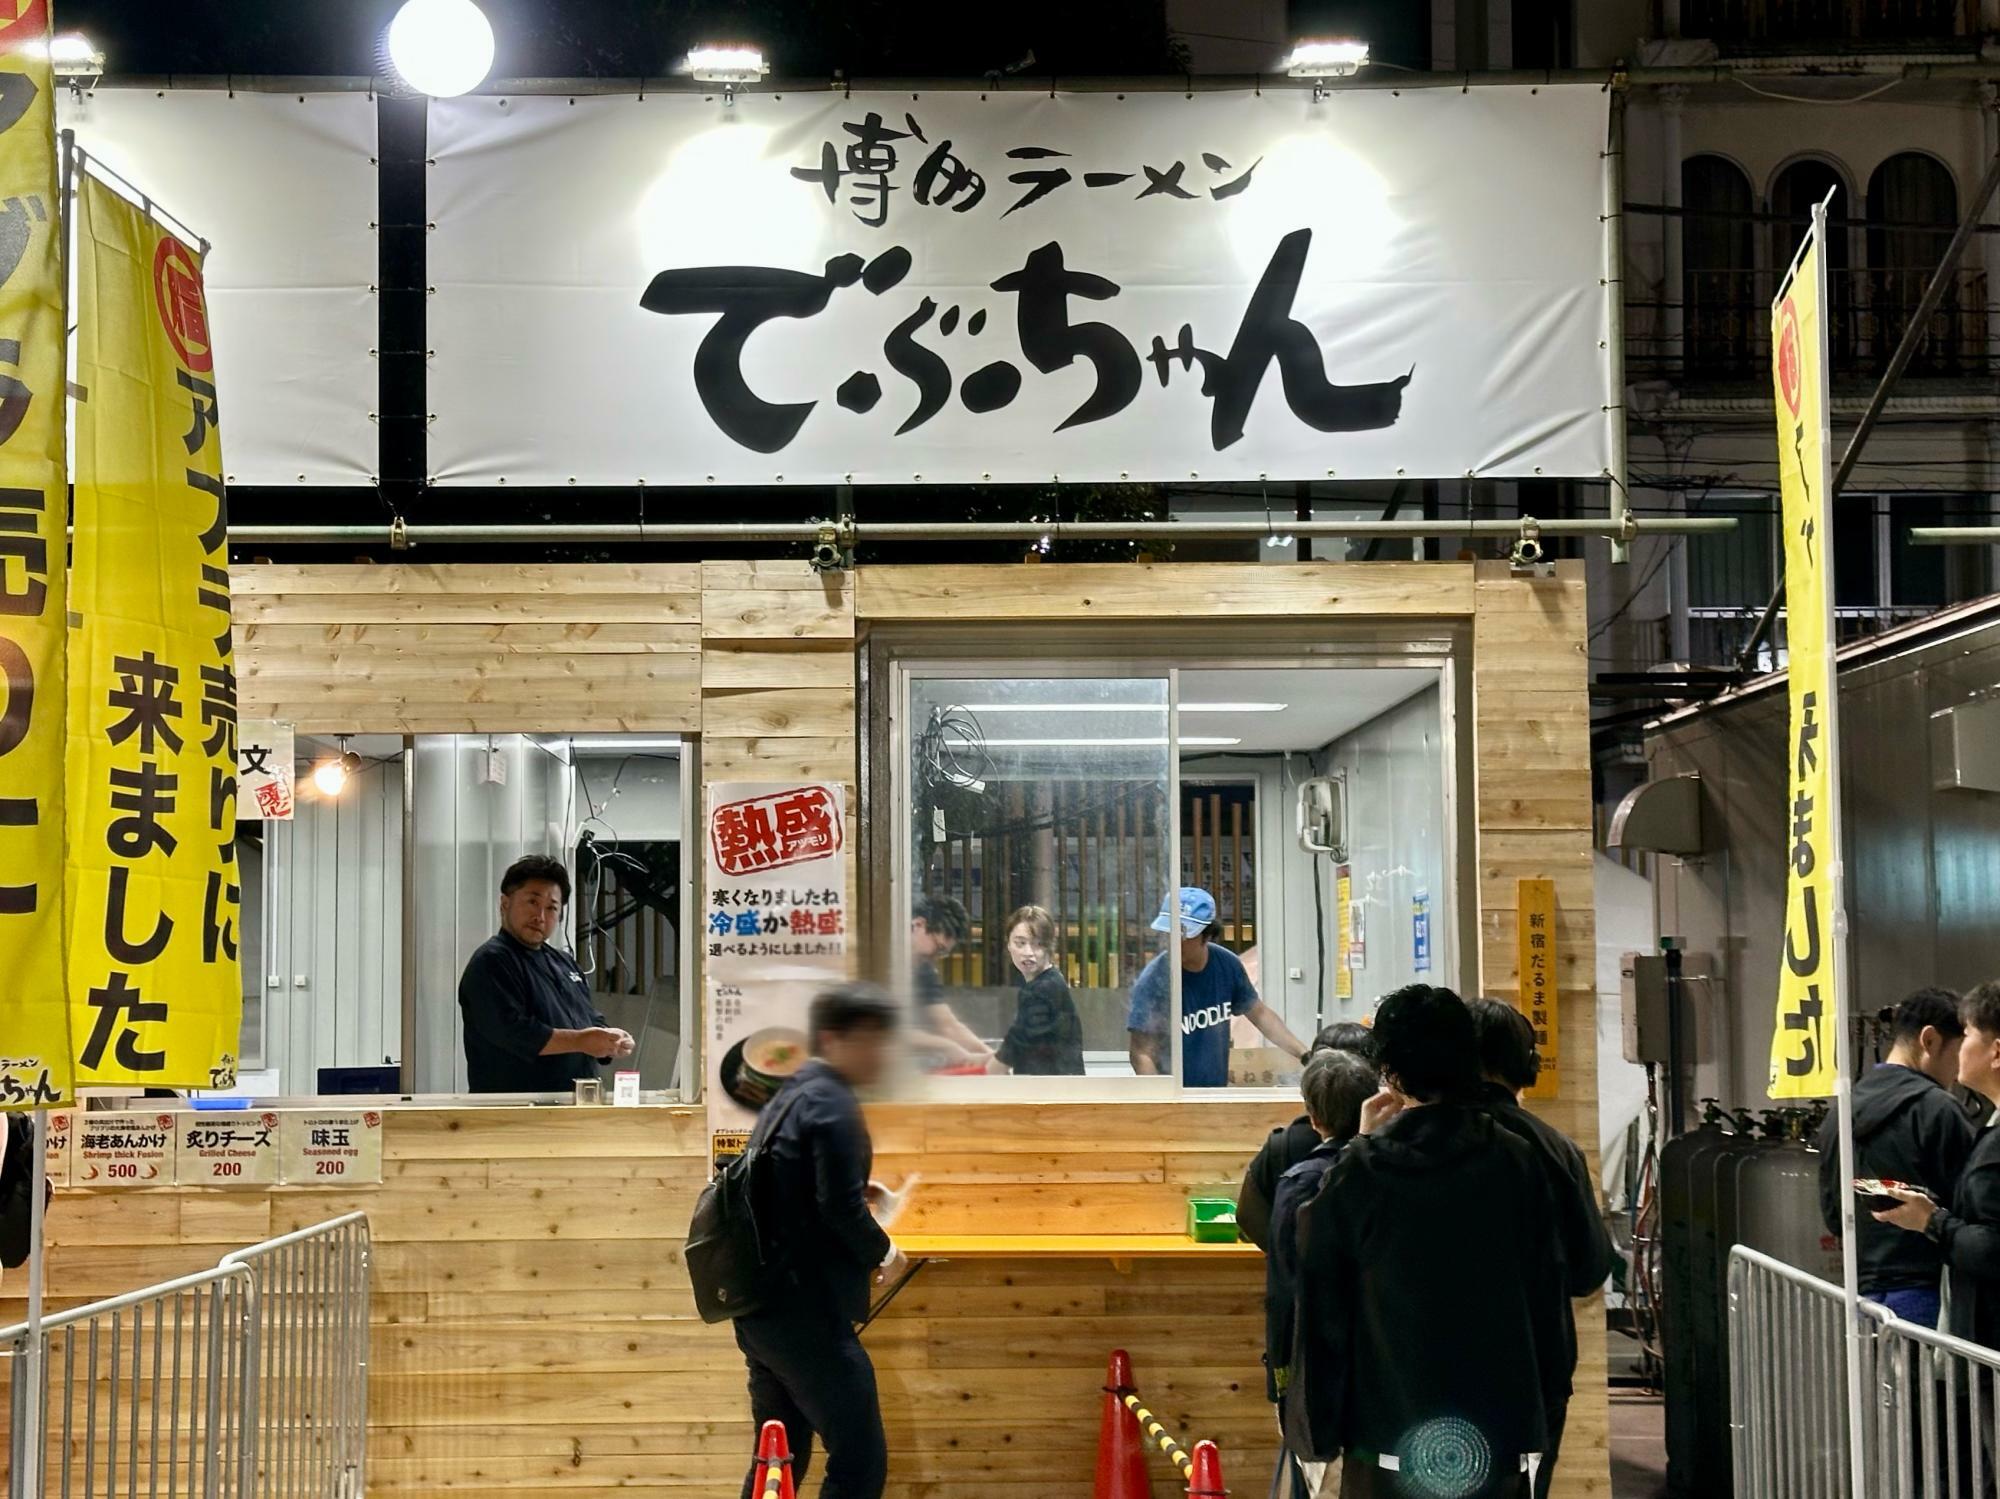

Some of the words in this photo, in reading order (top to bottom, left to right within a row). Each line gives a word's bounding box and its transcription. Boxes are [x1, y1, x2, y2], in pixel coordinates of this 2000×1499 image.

[791, 112, 1264, 226] 博多ラーメン
[639, 227, 1417, 453] でぶちゃん
[79, 651, 184, 1072] 来ました
[712, 888, 840, 907] 寒くなりましたね
[1181, 1001, 1231, 1035] NOODLE
[81, 1134, 167, 1149] 海老あんかけ
[186, 1128, 272, 1148] 炙りチーズ
[311, 1129, 350, 1147] 味玉
[83, 1151, 112, 1159] Shrimp
[199, 1149, 226, 1157] Grilled
[303, 1148, 341, 1156] Seasoned
[343, 1149, 359, 1157] egg
[108, 1164, 137, 1178] 500
[213, 1162, 242, 1176] 200
[316, 1161, 345, 1175] 200
